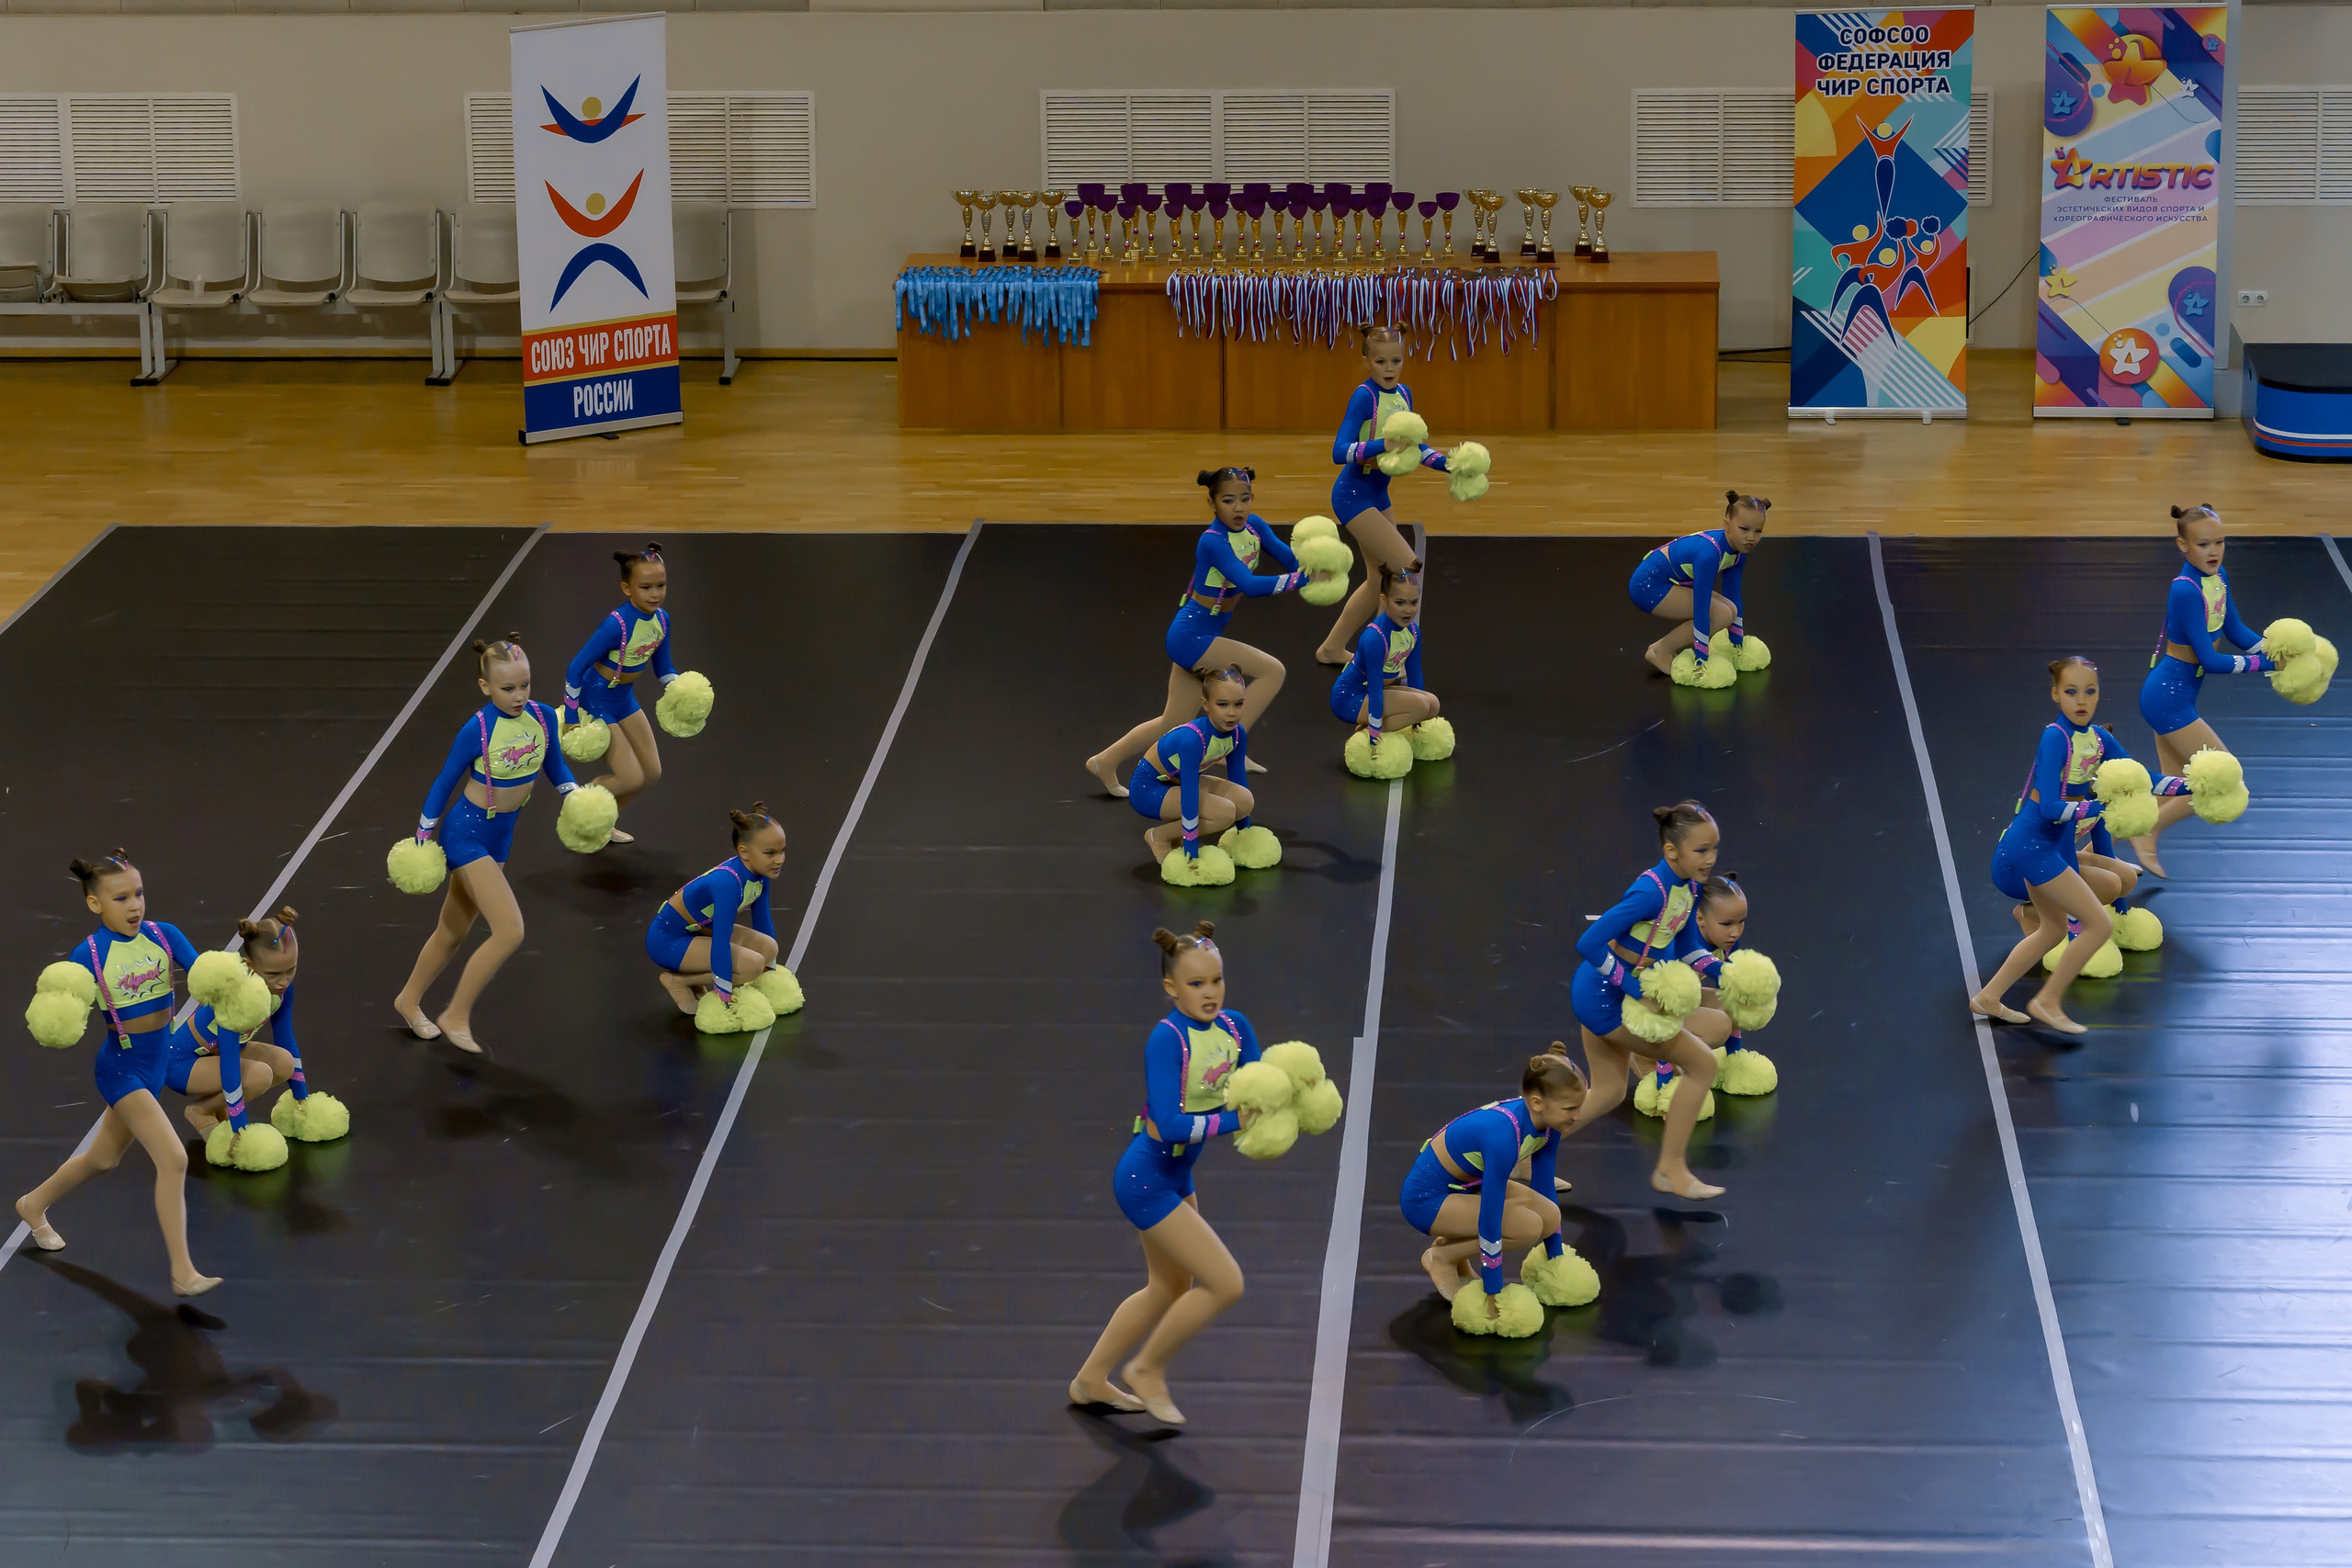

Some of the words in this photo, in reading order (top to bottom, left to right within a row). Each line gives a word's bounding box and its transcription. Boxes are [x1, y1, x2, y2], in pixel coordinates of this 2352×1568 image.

[1839, 26, 1929, 45] СОФСОО
[1817, 51, 1951, 73] ФЕДЕРАЦИЯ
[1817, 78, 1860, 96] ЧИР
[1866, 76, 1951, 95] СПОРТА
[2051, 147, 2214, 189] ARTISTIC
[531, 336, 574, 374] СОЮЗ
[579, 332, 609, 366] ЧИР
[614, 323, 672, 362] СПОРТА
[573, 378, 633, 418] РОССИИ
